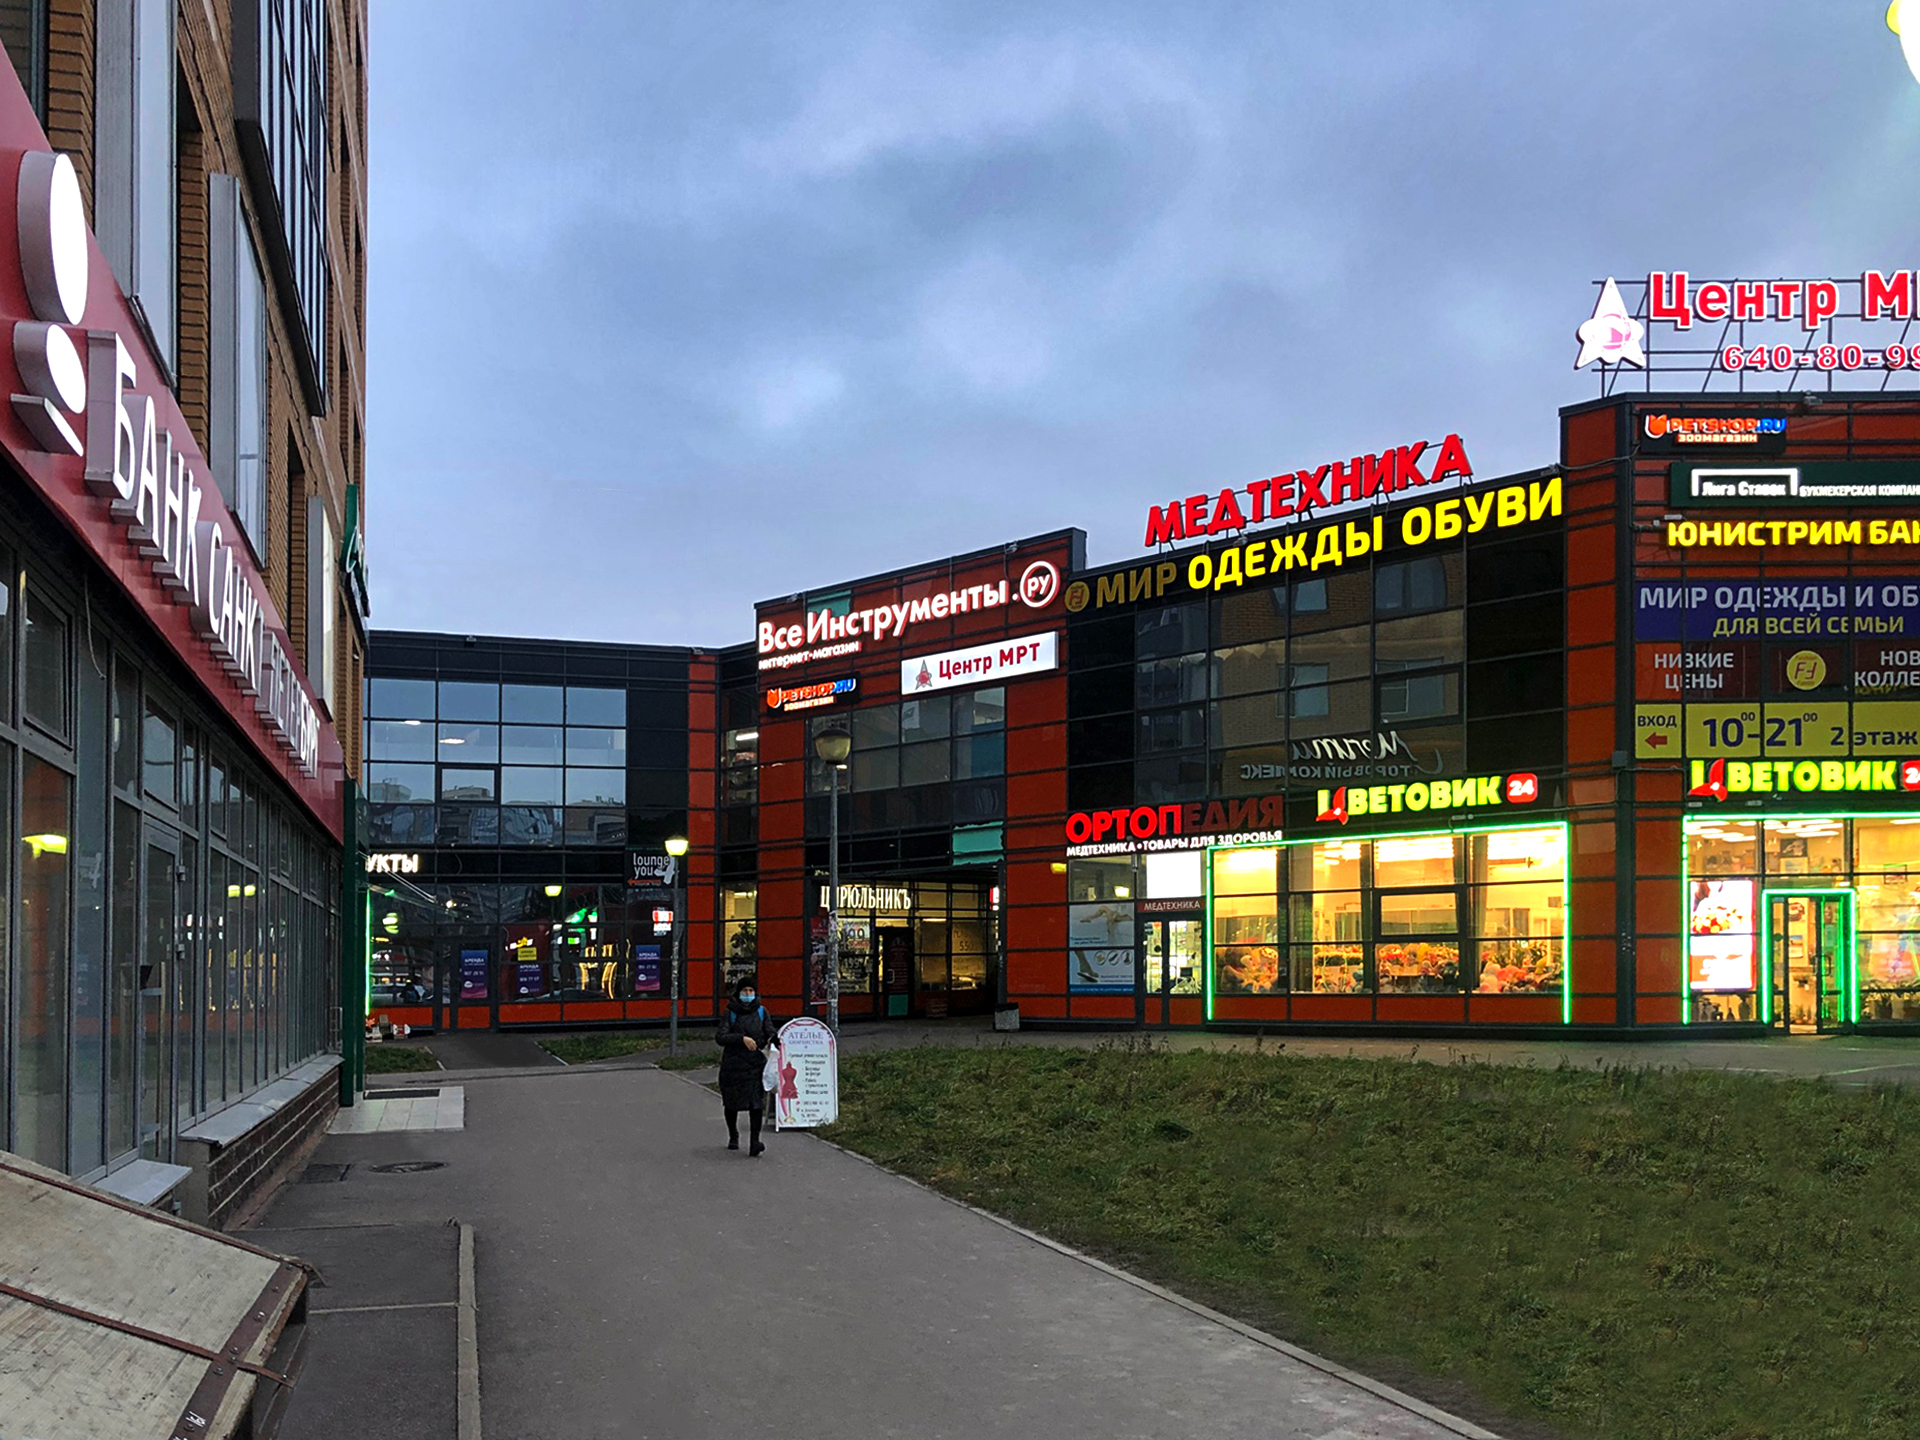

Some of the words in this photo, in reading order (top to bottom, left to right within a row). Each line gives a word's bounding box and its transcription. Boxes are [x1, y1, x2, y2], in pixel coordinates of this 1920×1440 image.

[1650, 271, 1839, 331] Центр
[1863, 270, 1920, 320] М
[1678, 434, 1758, 443] зоомагазин
[114, 332, 202, 607] БАНК
[1145, 434, 1473, 547] МЕДТЕХНИКА
[1702, 482, 1736, 496] Лига
[1738, 481, 1786, 496] Ставок
[1799, 485, 1877, 497] БУКМЕКЕРСКАЯ
[1096, 563, 1177, 608] МИР
[1187, 517, 1384, 591] ОДЕЖДЫ
[1402, 477, 1563, 546] ОБУВИ
[1668, 521, 1861, 546] ЮНИСТРИМ
[1640, 587, 1708, 609] МИР
[1714, 586, 1846, 613] ОДЕЖДЫ
[1855, 586, 1874, 607] И
[1881, 585, 1920, 607] ОБ
[1713, 618, 1759, 637] ДЛЯ
[1765, 613, 1821, 634] ВСЕЙ
[1827, 616, 1904, 634] СЕМЬИ
[758, 641, 861, 670] интернет-магазин
[939, 655, 992, 679] Центр
[999, 642, 1041, 668] МРТ
[1654, 653, 1734, 669] НИЗКИЕ
[1665, 674, 1723, 692] ЦЕНЫ
[783, 696, 835, 711] зоомагазин
[1637, 715, 1678, 728] ВХОД
[1830, 727, 1845, 746] 2
[1854, 731, 1918, 746] этаж
[1687, 759, 1897, 801] ЦВЕТОВИК
[1905, 767, 1920, 784] 2
[1316, 776, 1502, 825] ЦВЕТОВИК
[1508, 779, 1534, 796] 24
[1065, 796, 1285, 844] ОРТОПЕДИЯ
[1066, 841, 1136, 857] МЕДТЕХНИКА
[1142, 837, 1189, 851] ТОВАРЫ
[1190, 835, 1215, 848] ДЛЯ
[1217, 830, 1283, 847] ЗДОРОВЬЯ
[633, 852, 670, 869] lounge
[634, 866, 654, 879] you
[1144, 900, 1201, 911] МЕДТЕХНИКА
[788, 1031, 824, 1039] АТЕЛЬЕ
